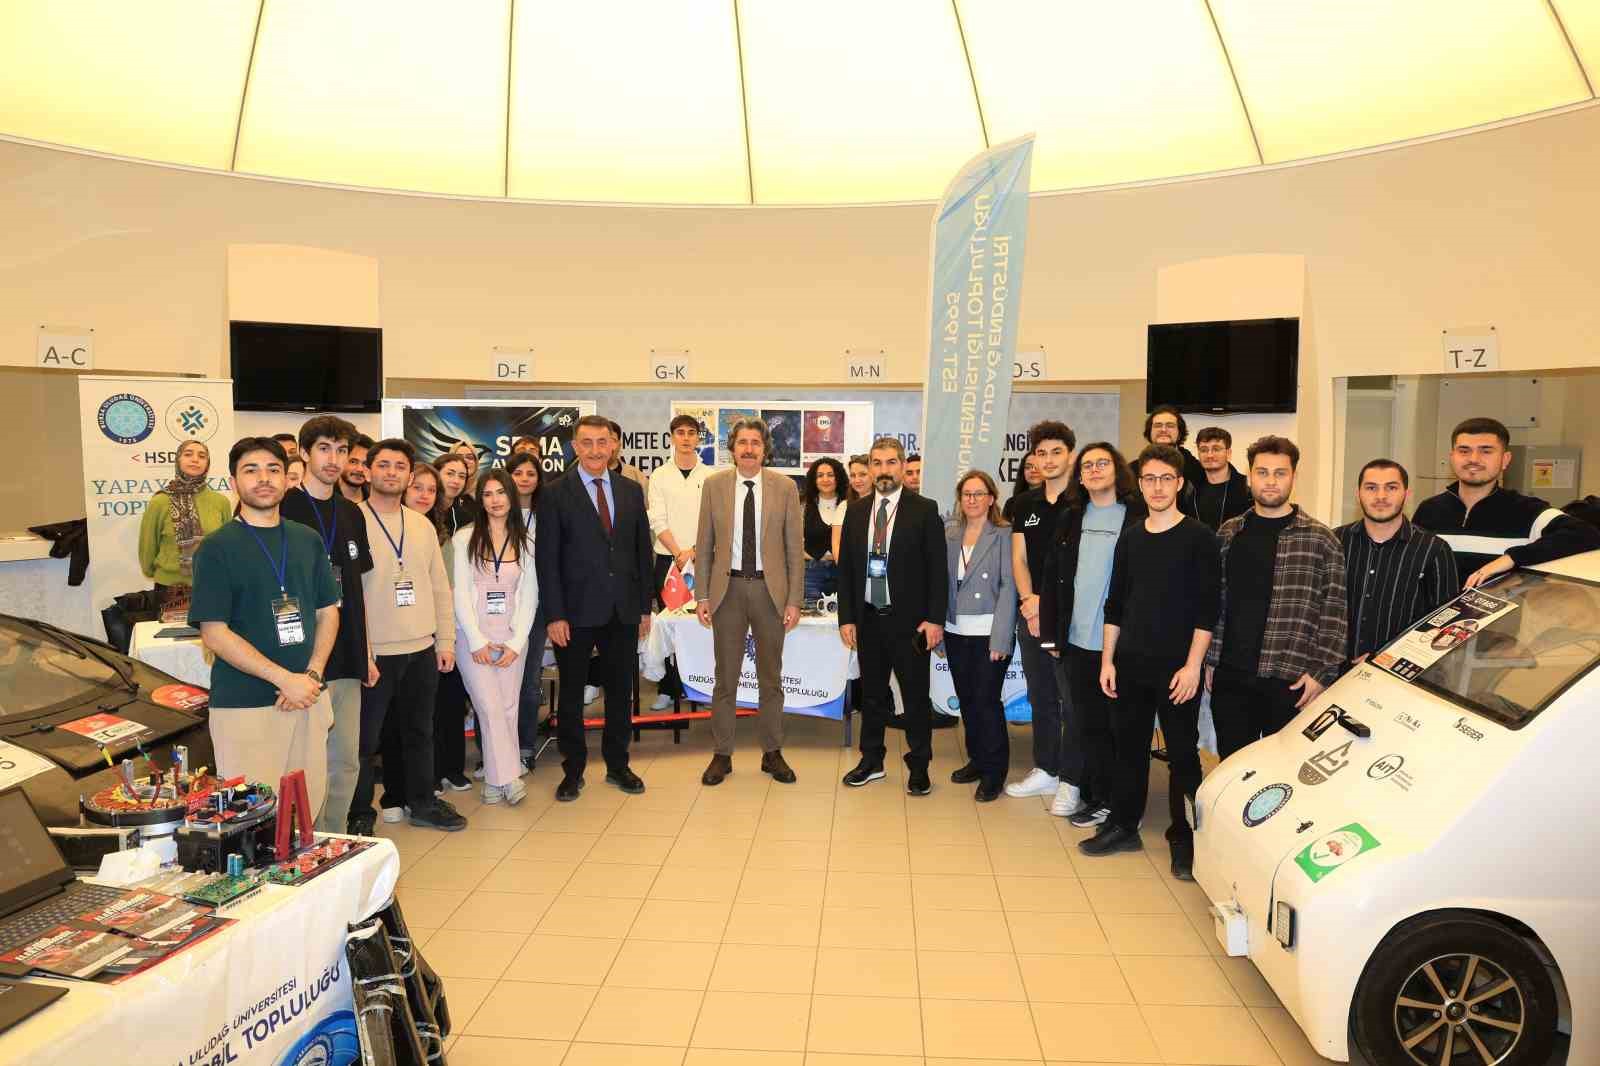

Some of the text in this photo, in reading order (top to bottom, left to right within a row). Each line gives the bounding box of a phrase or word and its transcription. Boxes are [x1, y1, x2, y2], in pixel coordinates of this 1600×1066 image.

[43, 346, 87, 366] A-C
[1449, 349, 1487, 368] T-Z
[497, 363, 528, 379] D-F
[655, 365, 686, 380] G-K
[850, 365, 880, 377] M-N
[622, 431, 658, 449] METE
[97, 500, 148, 517] TOP
[242, 960, 341, 1050] TOPLULUĞU
[189, 976, 297, 1065] ULUDAĞ ÜNİVERSİTESİ
